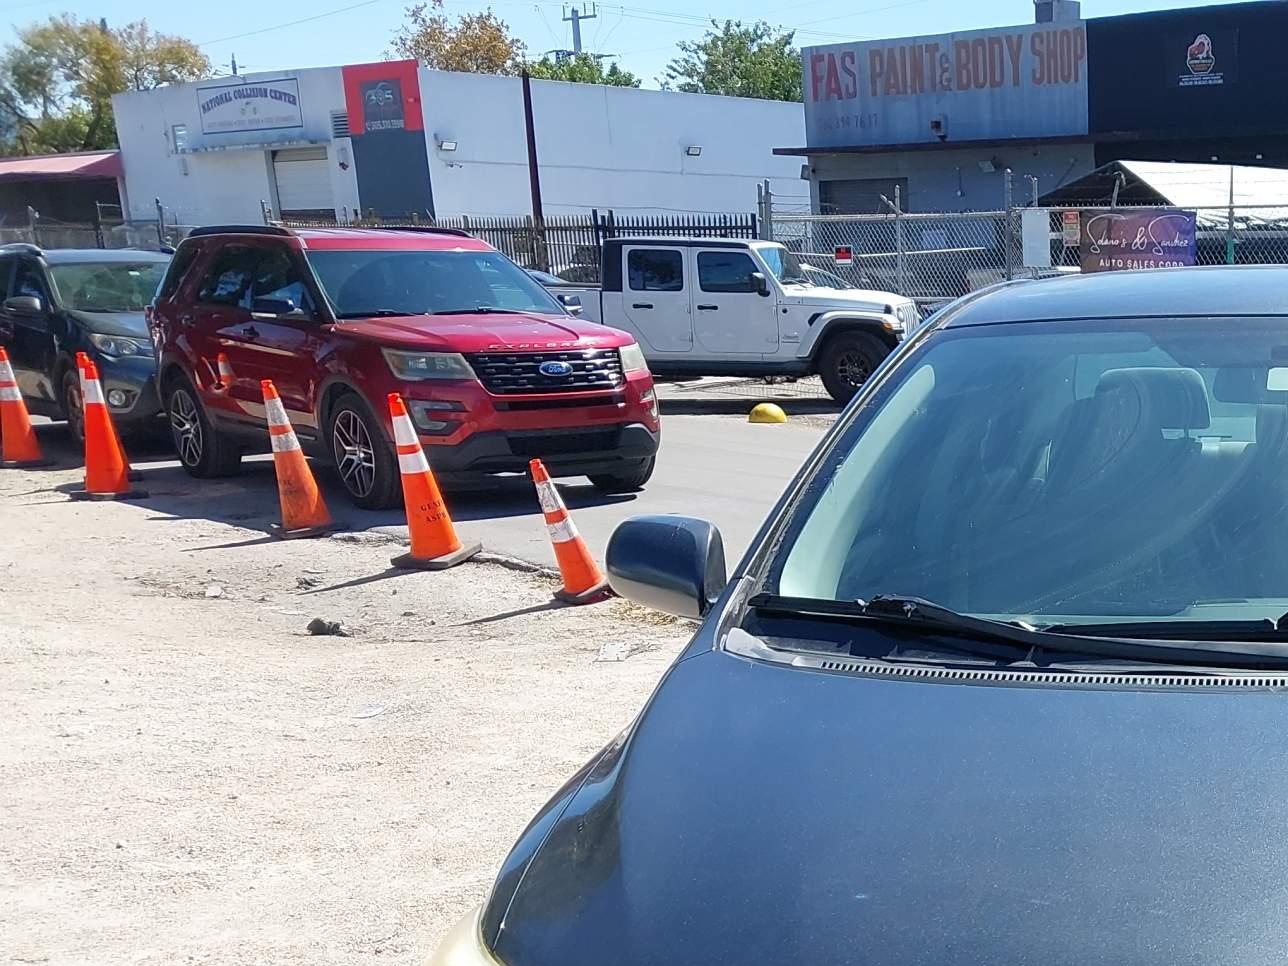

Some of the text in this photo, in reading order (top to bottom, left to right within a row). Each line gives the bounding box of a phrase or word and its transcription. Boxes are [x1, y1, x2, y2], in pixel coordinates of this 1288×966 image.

[810, 27, 1086, 102] FAS PAINT & BODY SHOP
[201, 87, 298, 114] NATIONAL COLLISION CENTER
[1147, 214, 1190, 256] Sanchez
[1099, 258, 1124, 268] AUTO
[1126, 259, 1155, 270] SALES
